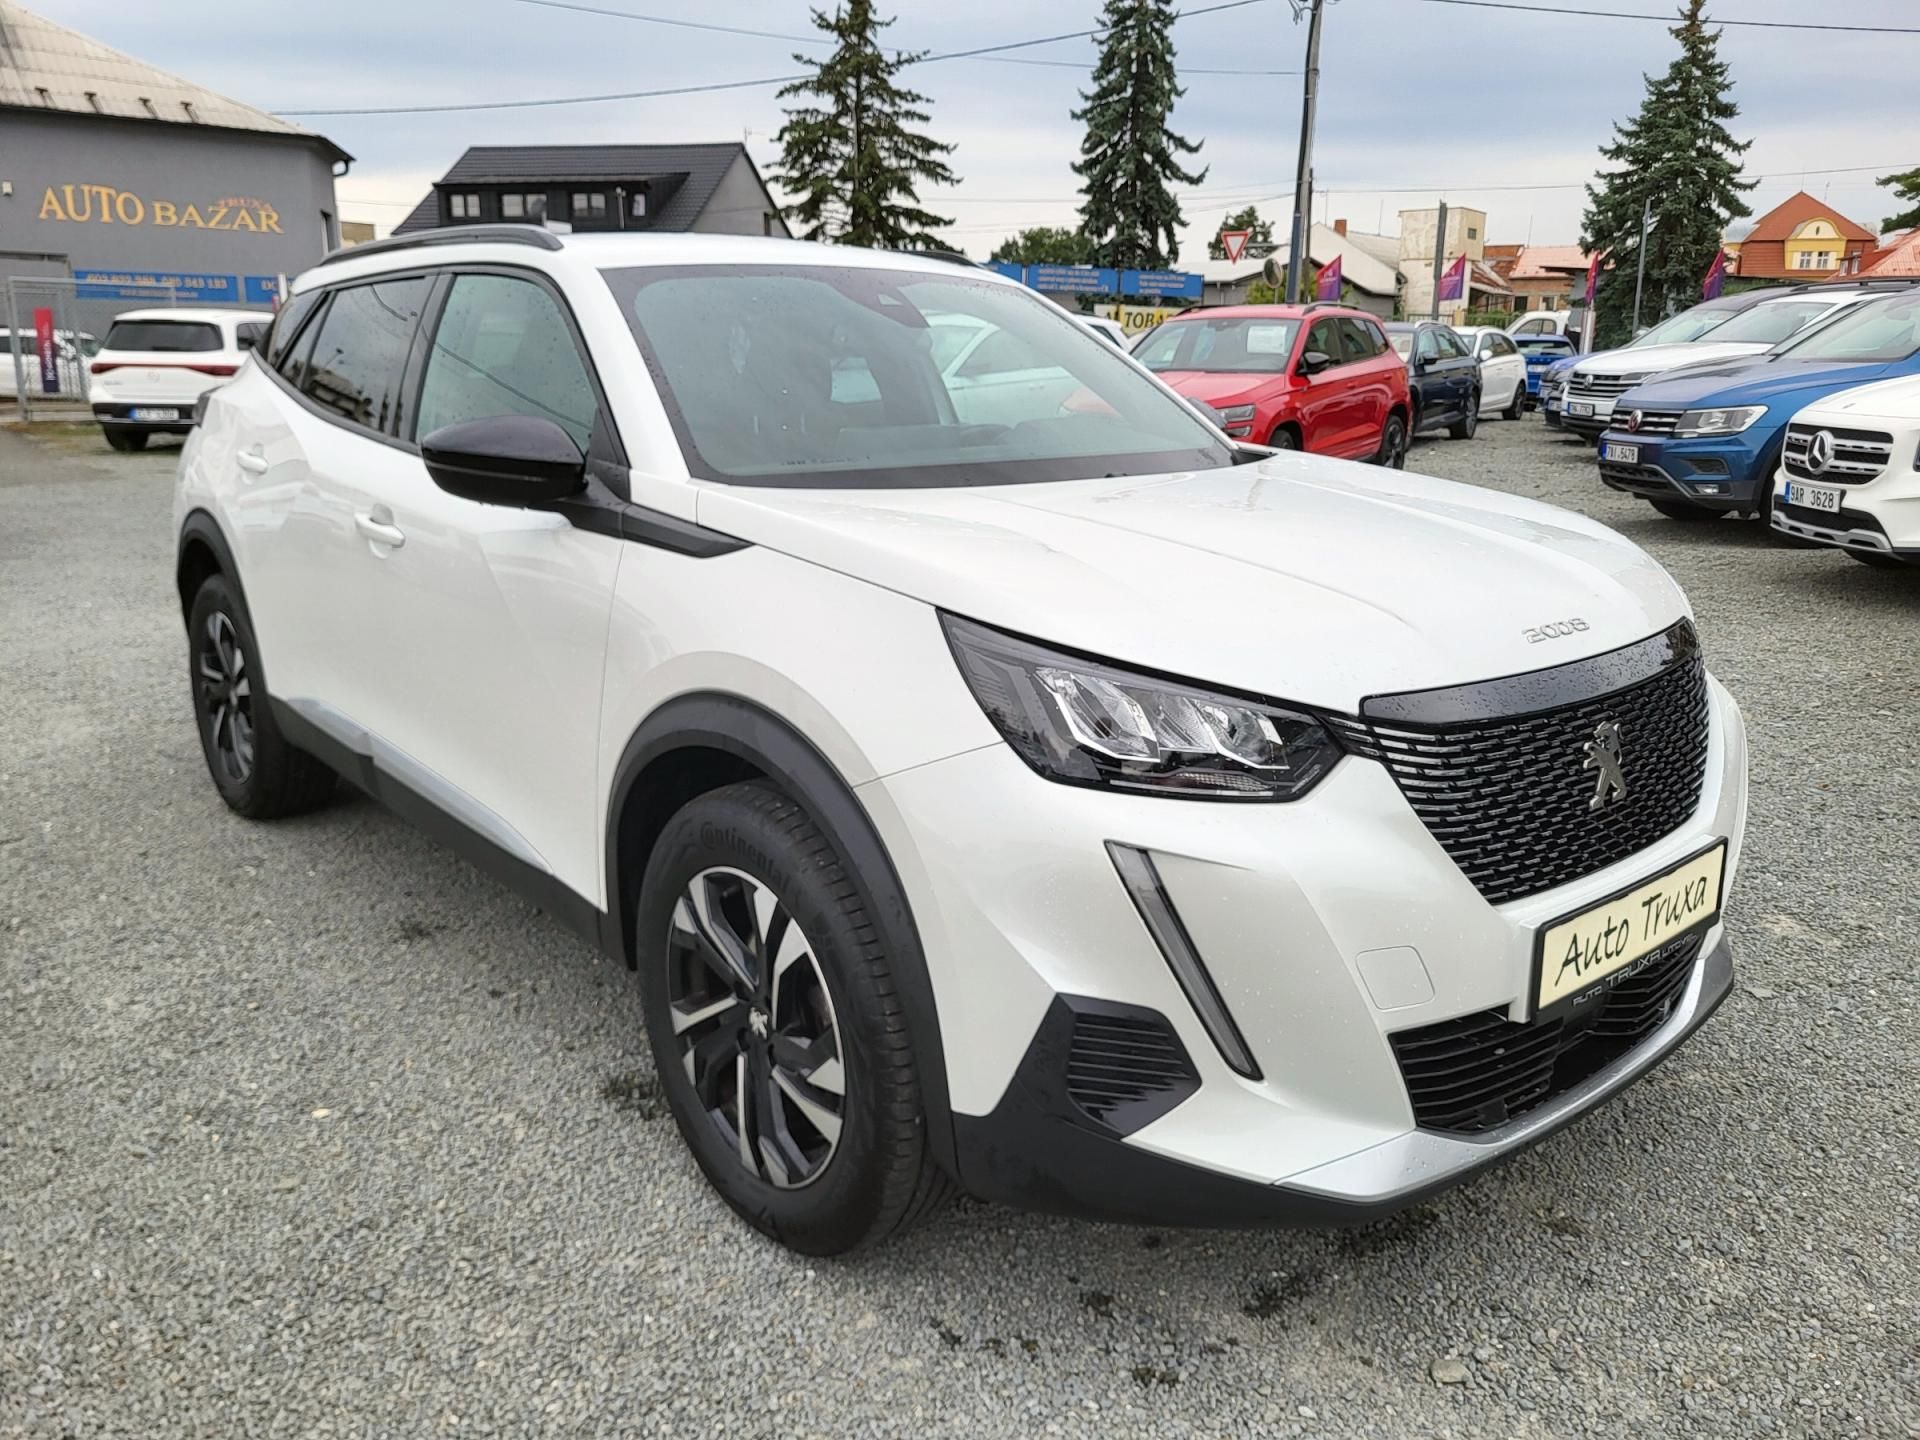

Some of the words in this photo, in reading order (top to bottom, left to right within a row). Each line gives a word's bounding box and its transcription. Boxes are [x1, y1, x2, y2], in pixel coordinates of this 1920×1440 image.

[39, 184, 145, 224] AUTO
[153, 202, 285, 234] BAZAR
[1791, 486, 1805, 504] 9AR
[1810, 489, 1834, 509] 3628
[1522, 618, 1590, 644] 2008
[1555, 915, 1630, 988] Auto
[1642, 875, 1708, 942] Truxa
[1605, 949, 1661, 988] TRUXA
